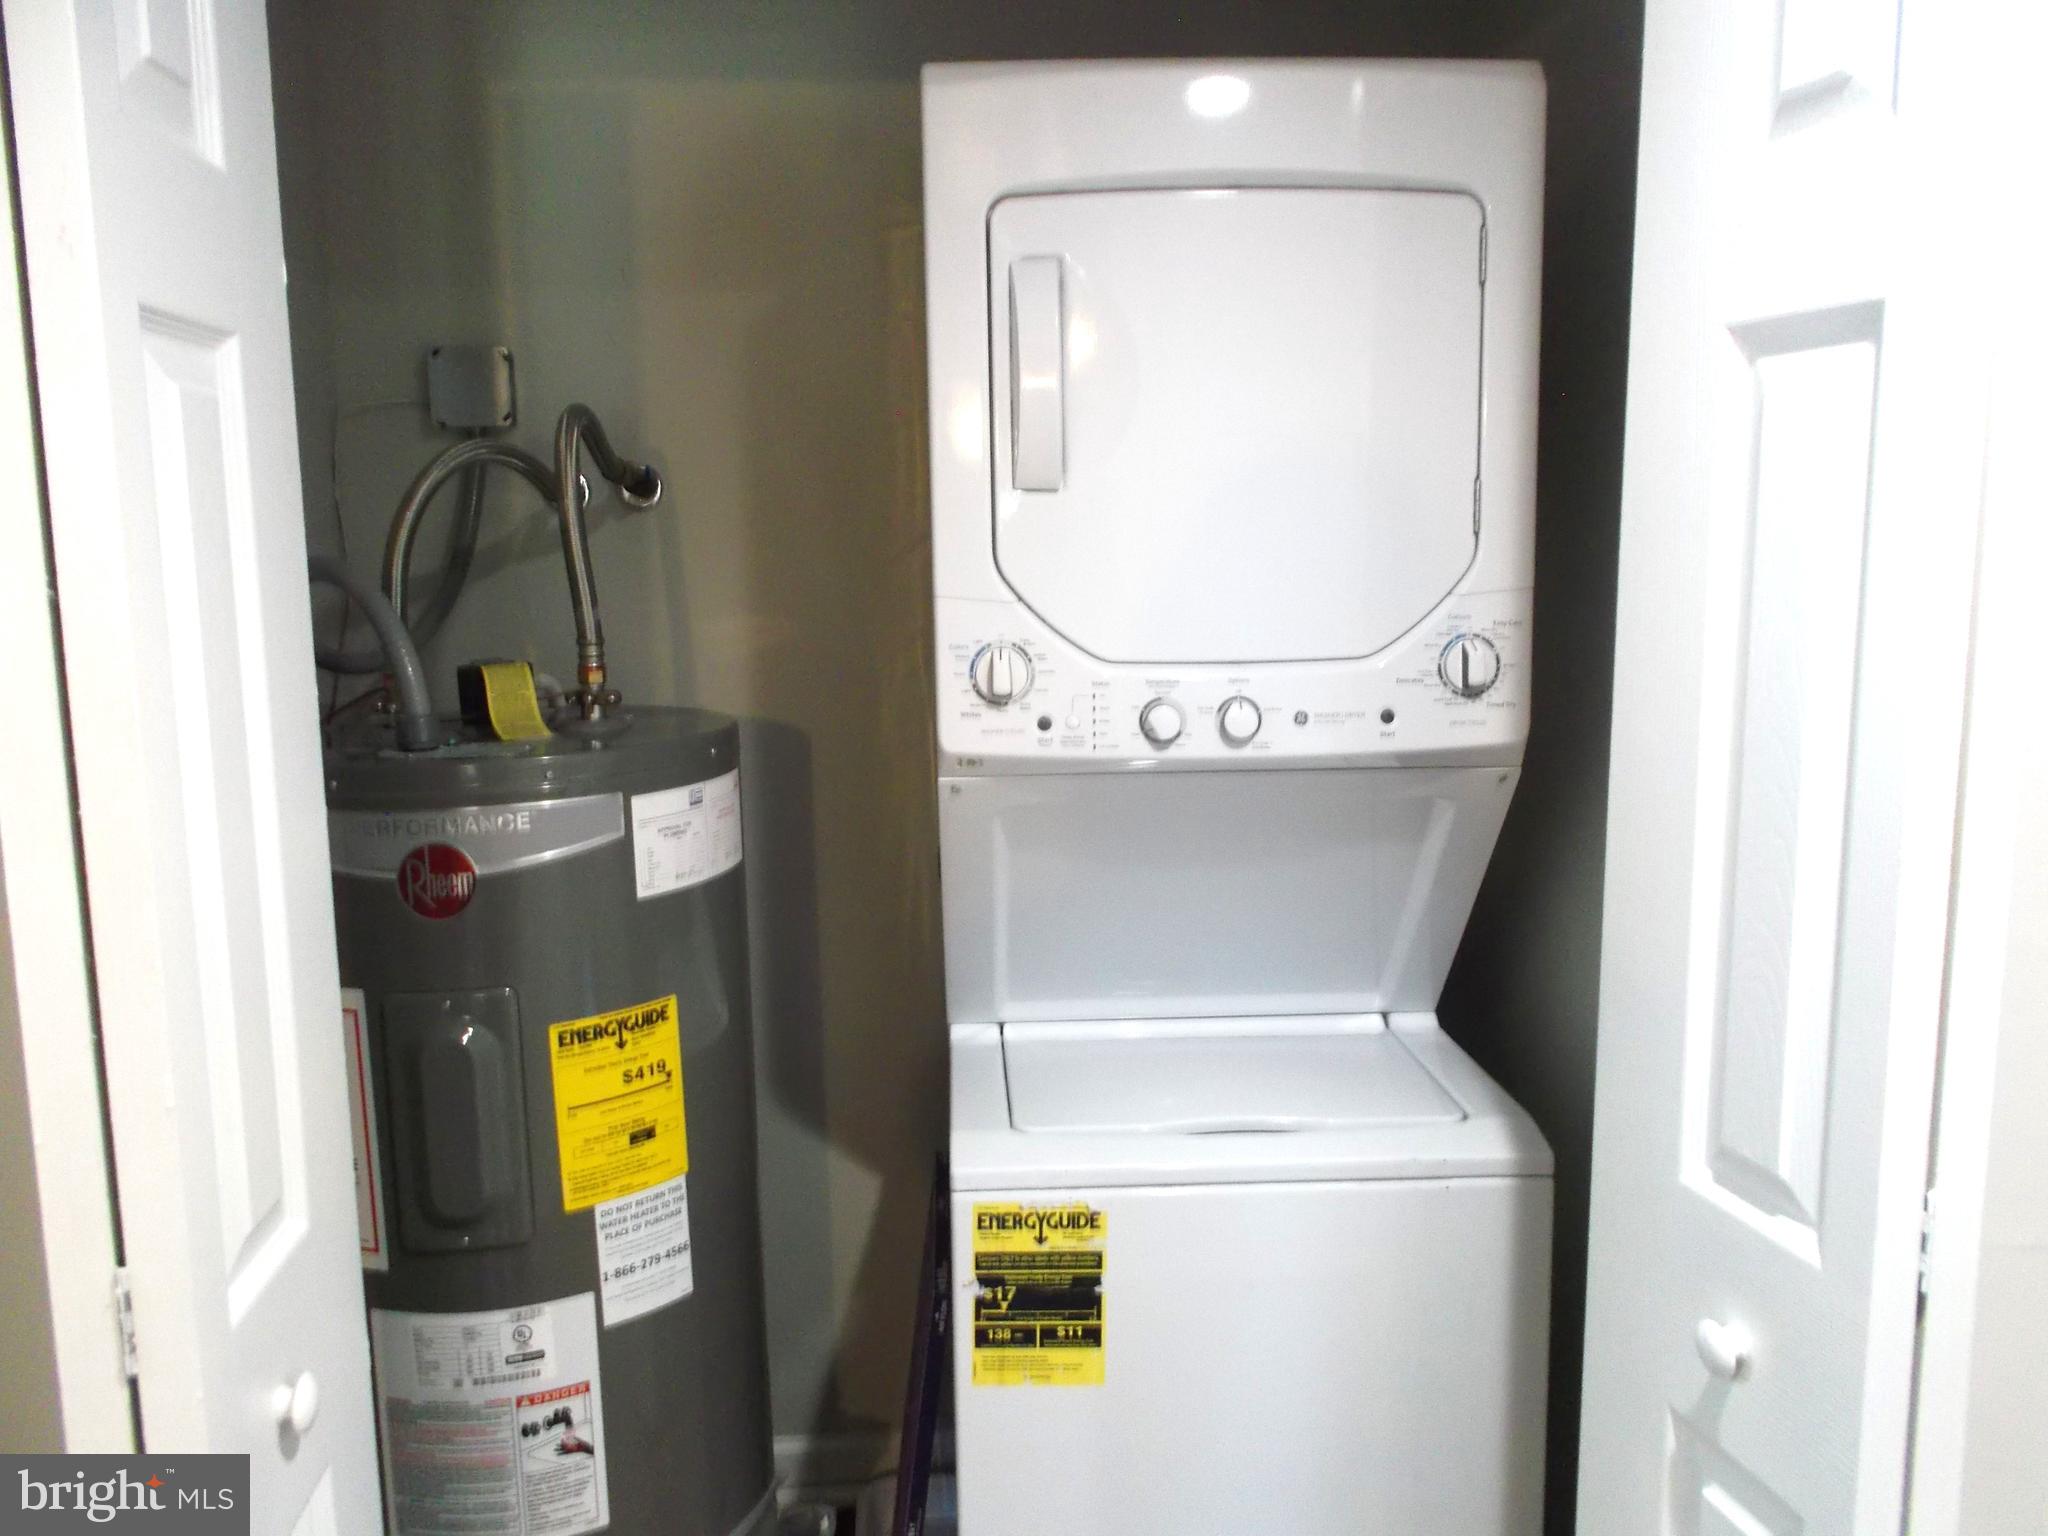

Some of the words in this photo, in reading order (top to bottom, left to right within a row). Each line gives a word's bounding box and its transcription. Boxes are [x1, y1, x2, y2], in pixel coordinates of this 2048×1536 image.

[350, 811, 532, 839] ERFORMANCE
[403, 845, 474, 908] Rheem
[622, 1058, 666, 1084] $419
[616, 1200, 633, 1213] NOT
[977, 1210, 1101, 1241] ENERGYGUIDE
[983, 1285, 1017, 1303] $17
[1057, 1325, 1083, 1338] $11
[534, 1384, 589, 1404] DANGER
